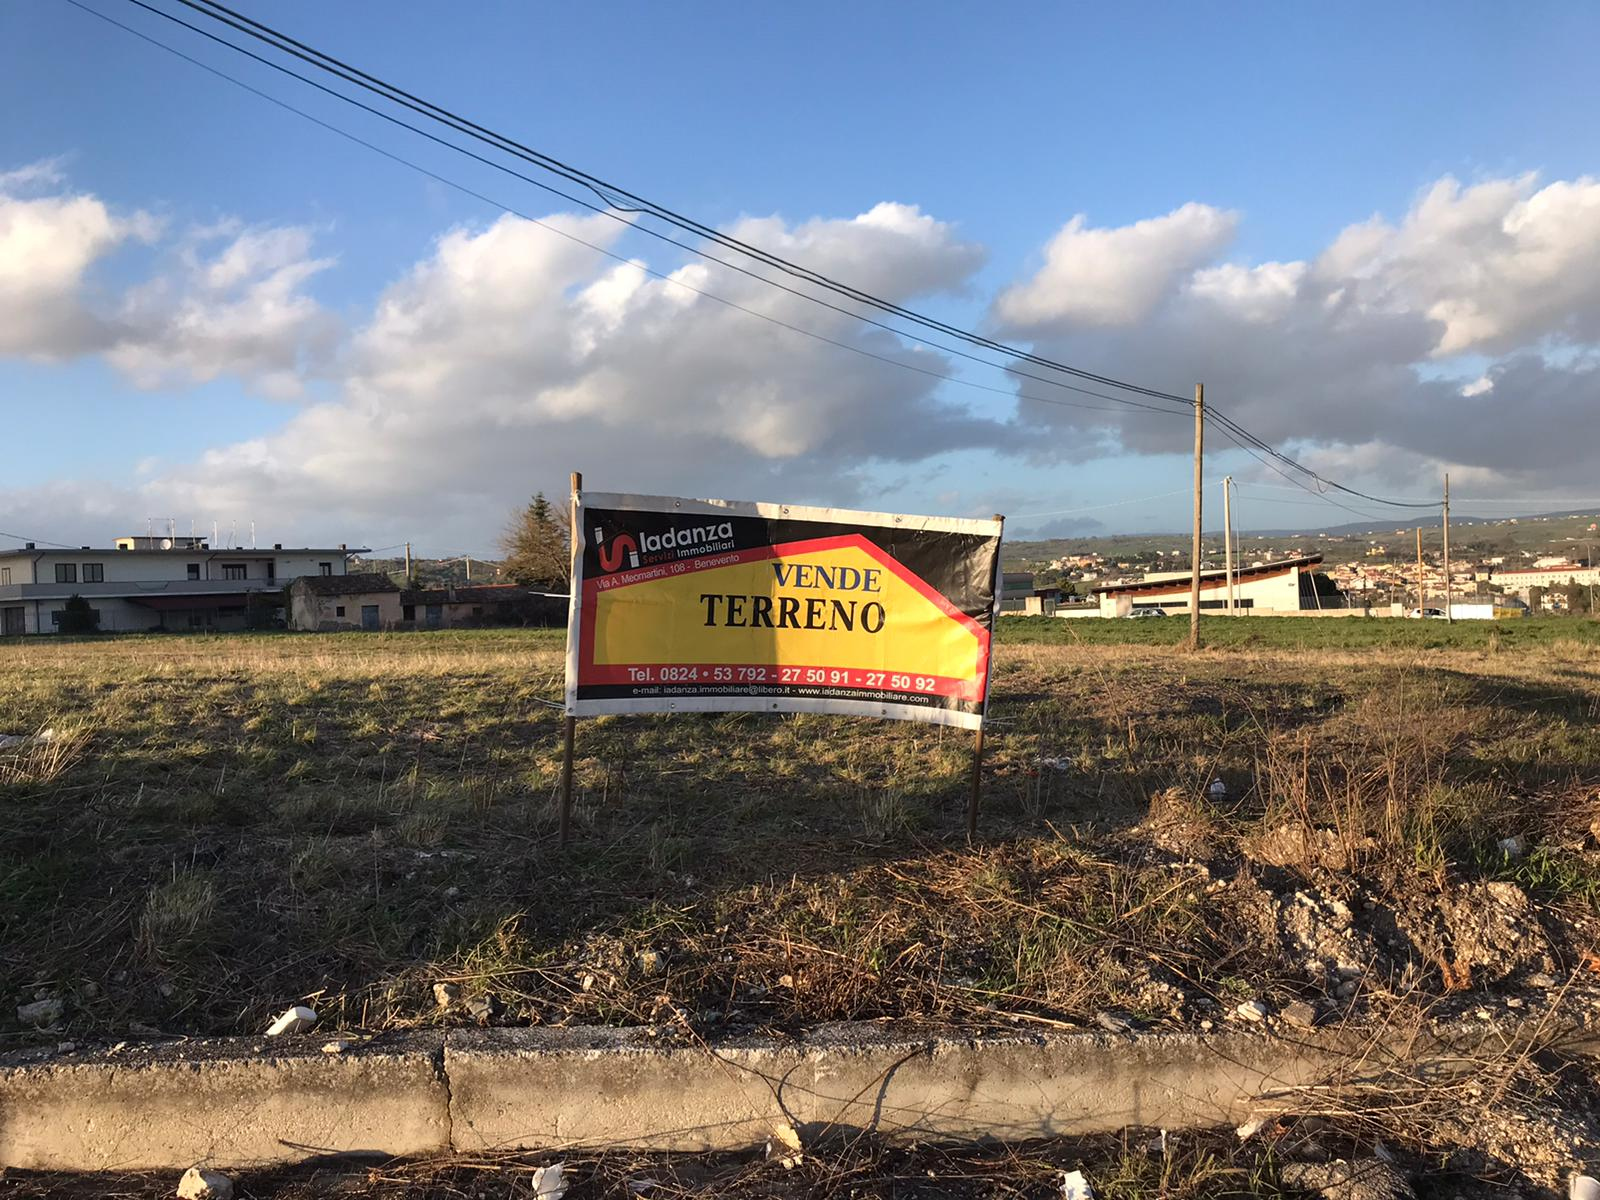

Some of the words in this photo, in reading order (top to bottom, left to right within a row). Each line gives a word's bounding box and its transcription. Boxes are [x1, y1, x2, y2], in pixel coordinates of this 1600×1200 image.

[596, 578, 611, 589] Via
[611, 575, 619, 586] A.
[621, 566, 668, 584] Meomartini,
[670, 563, 686, 574] 108
[694, 554, 740, 570] Benevento
[772, 562, 882, 593] VENDE
[700, 593, 886, 634] TERRENO
[628, 667, 655, 682] Tel.
[659, 667, 698, 682] 0824
[713, 667, 733, 682] 53
[737, 668, 767, 682] 792
[781, 668, 801, 682] 27
[806, 669, 825, 683] 50
[830, 670, 849, 685] 91
[865, 673, 886, 687] 27
[891, 675, 911, 690] 50
[915, 677, 936, 692] 92
[632, 687, 661, 695] e-mail:
[798, 686, 929, 703] www.iadanzaimmobiliare.com
